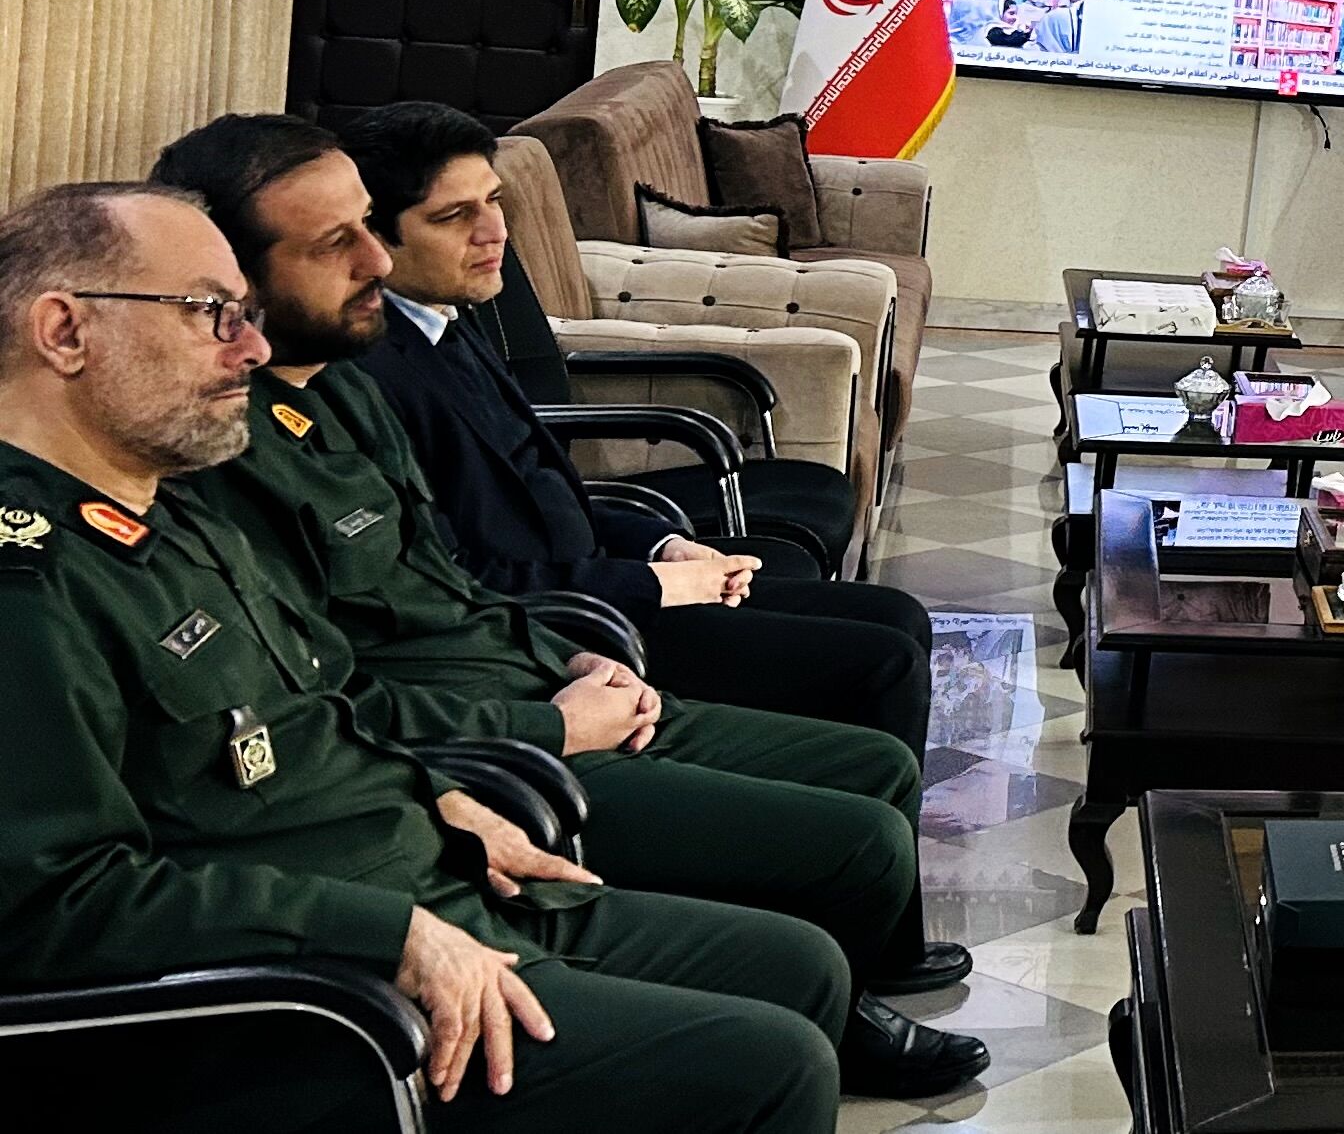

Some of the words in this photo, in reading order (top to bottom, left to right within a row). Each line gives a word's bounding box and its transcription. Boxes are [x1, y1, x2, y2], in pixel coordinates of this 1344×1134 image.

[985, 52, 1006, 62] دقیق
[1050, 59, 1073, 68] انجام
[1095, 60, 1122, 72] حوادث
[1172, 68, 1187, 77] آمار
[1187, 70, 1208, 81] اعلام
[1209, 73, 1218, 81] در
[1241, 74, 1261, 84] اصلی
